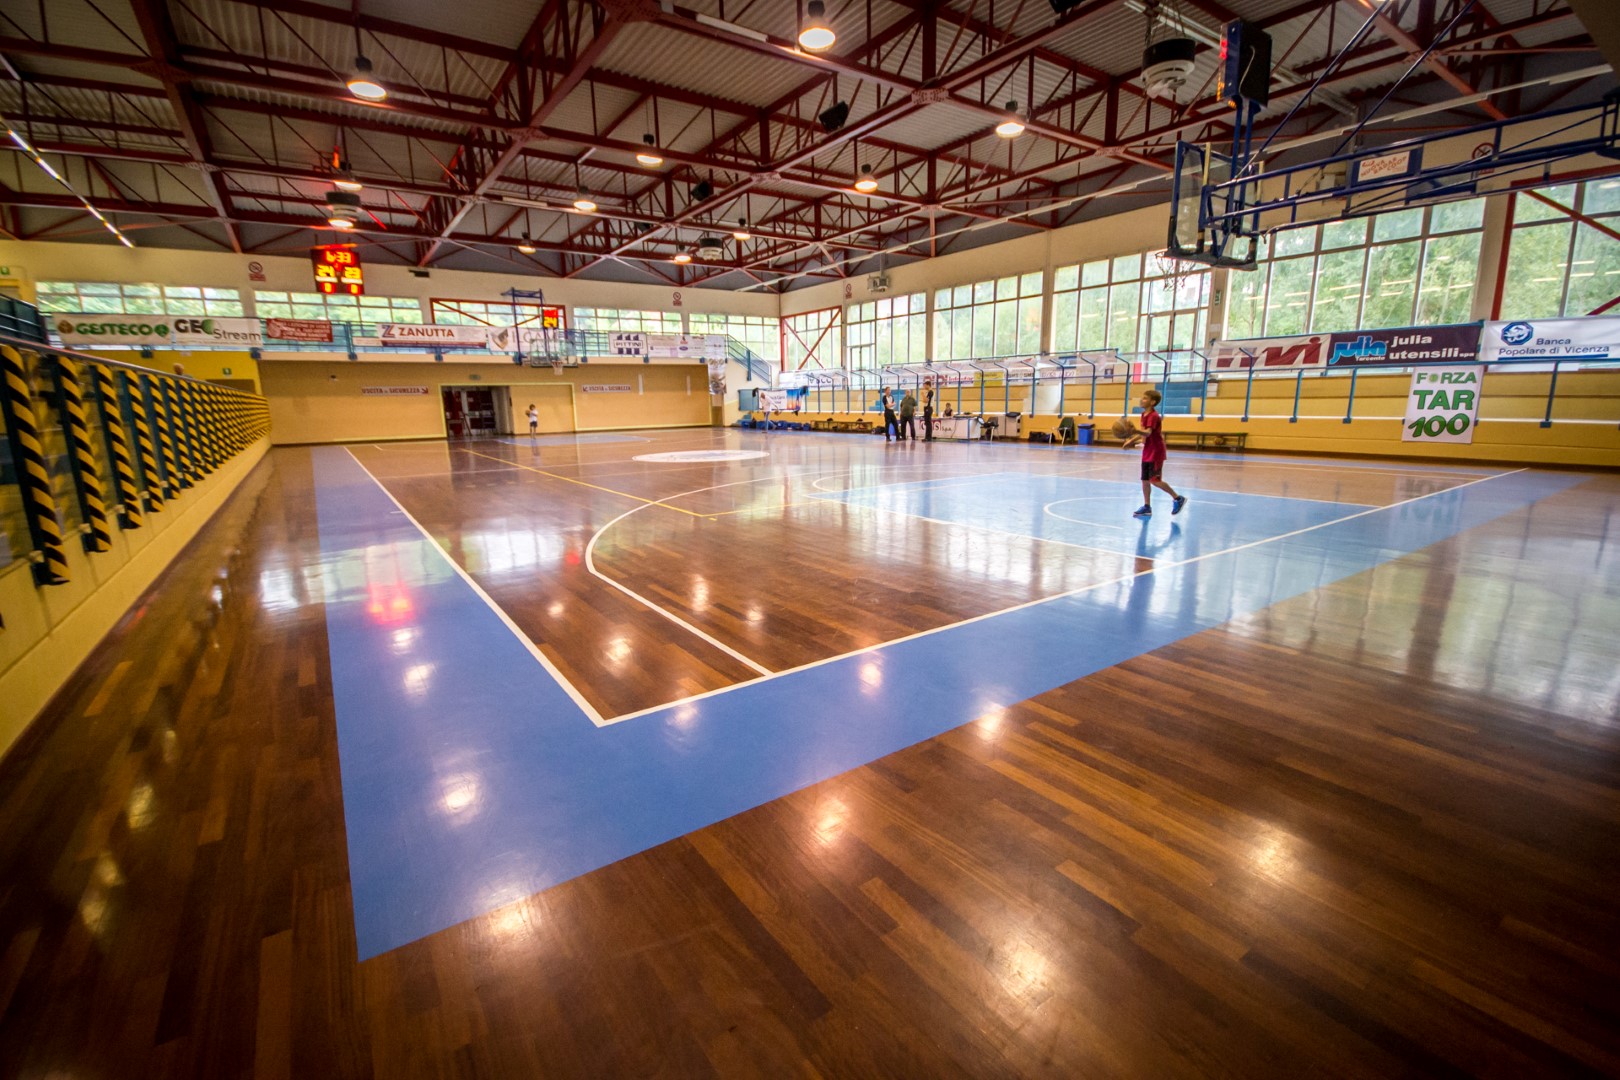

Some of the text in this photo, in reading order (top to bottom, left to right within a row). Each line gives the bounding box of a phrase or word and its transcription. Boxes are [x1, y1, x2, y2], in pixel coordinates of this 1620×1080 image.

[75, 323, 154, 336] GESTECO
[212, 328, 262, 341] Stream
[397, 327, 455, 338] ZANUTTA
[1390, 334, 1433, 348] julia
[1536, 338, 1572, 346] Banca
[1389, 348, 1460, 360] utensili
[1498, 345, 1610, 357] Popolare di Vicenza
[1412, 389, 1475, 411] TAR
[1407, 412, 1471, 438] 100
